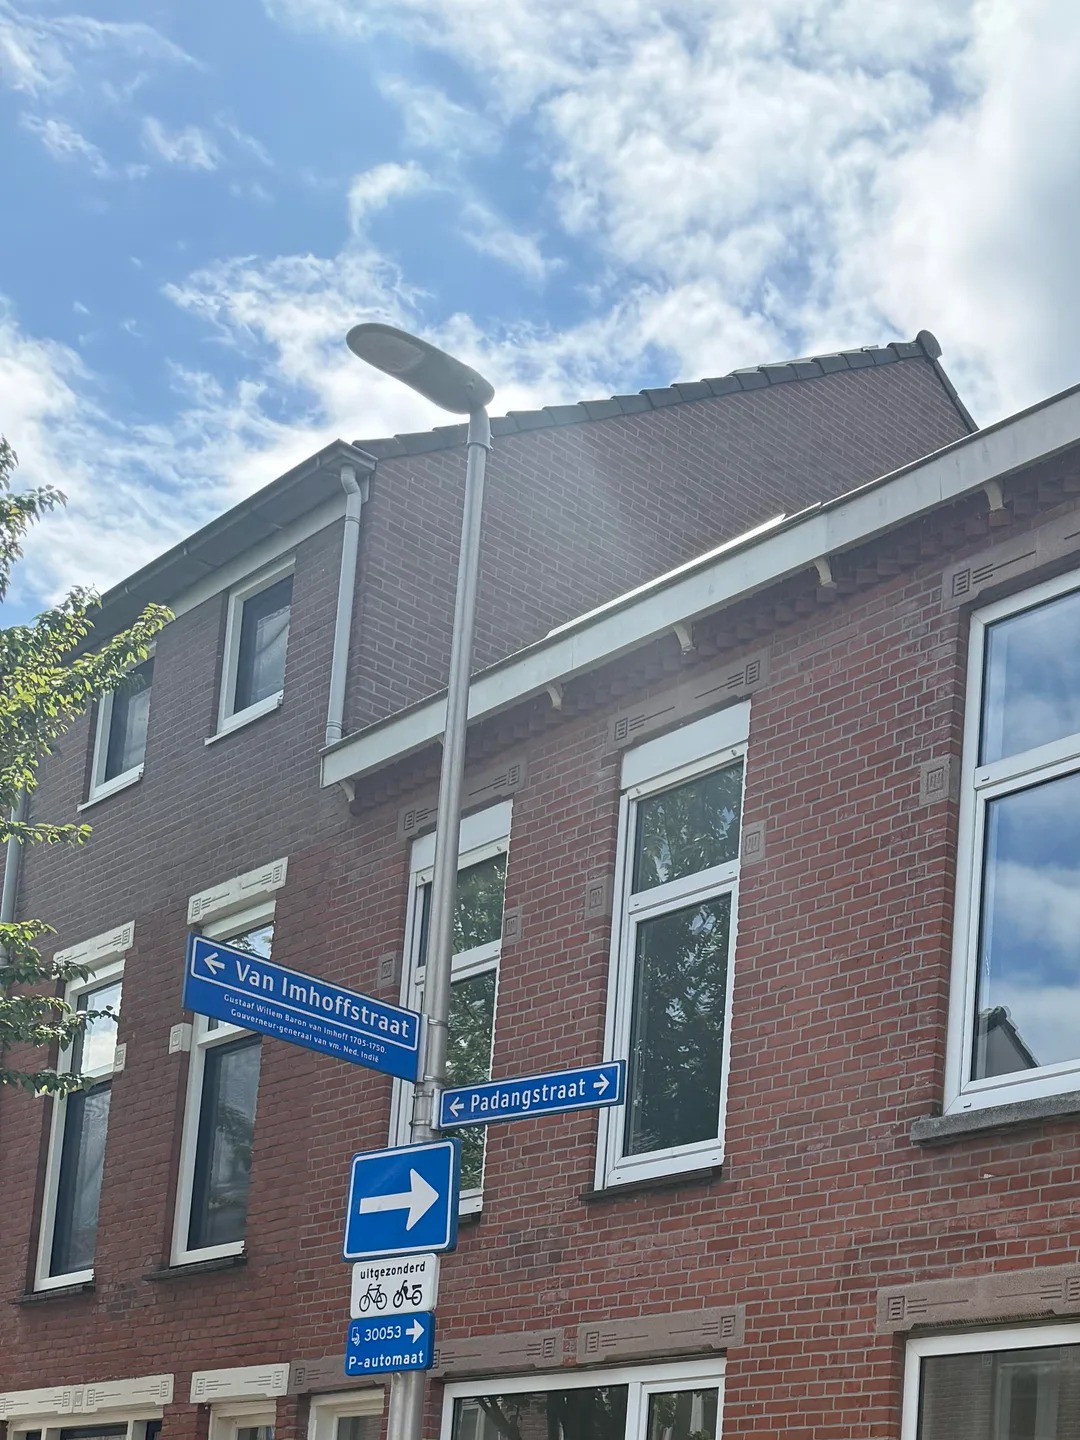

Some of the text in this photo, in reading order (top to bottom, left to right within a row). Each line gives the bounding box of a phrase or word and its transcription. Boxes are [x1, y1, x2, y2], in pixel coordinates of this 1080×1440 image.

[223, 993, 255, 1010] Gustaaf
[256, 1003, 283, 1020] Willem
[285, 1013, 307, 1027] Baron
[308, 1023, 322, 1032] van
[323, 1026, 349, 1041] Imhoff
[236, 960, 409, 1039] Van Imhoffstraat
[230, 1008, 380, 1063] Gouverneur-generaal van vm. Ned. Indië
[470, 1078, 586, 1113] Padangstraat
[360, 1261, 426, 1281] uitgezonderd
[364, 1325, 402, 1342] 30053
[348, 1350, 424, 1370] P-automaat
